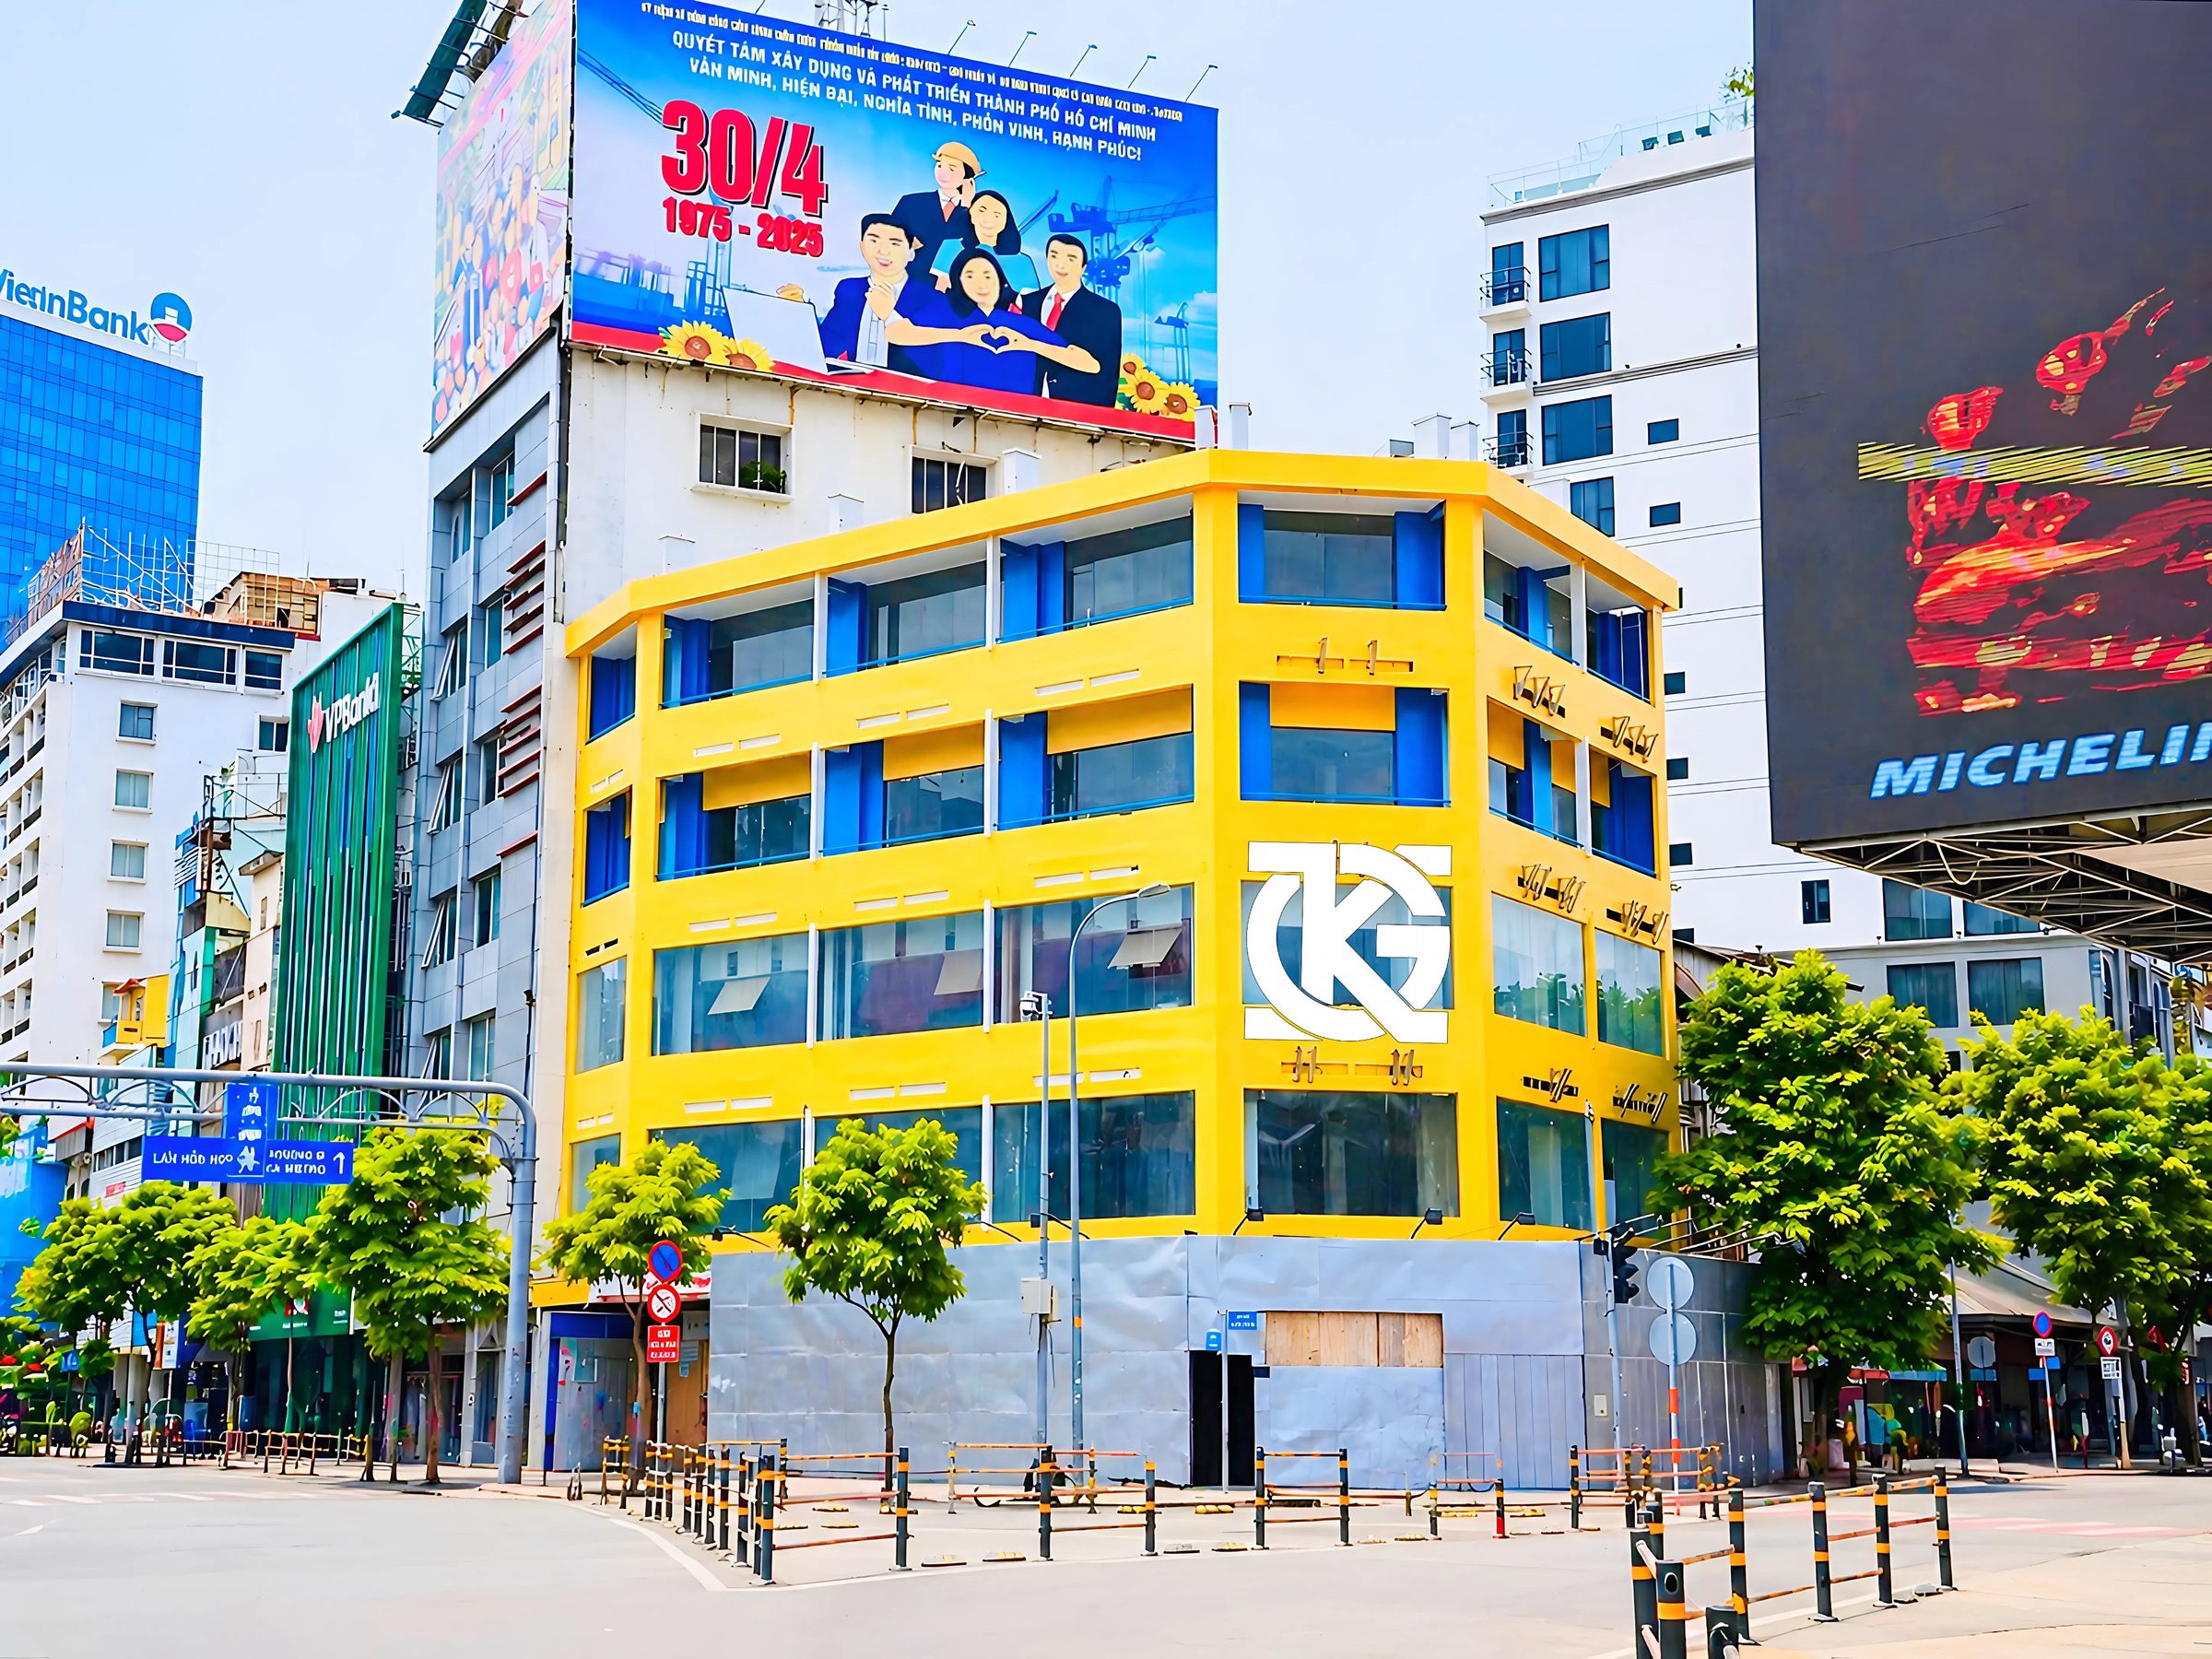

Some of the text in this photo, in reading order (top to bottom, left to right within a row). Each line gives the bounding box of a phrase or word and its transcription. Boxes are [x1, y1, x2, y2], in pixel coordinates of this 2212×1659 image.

[1117, 121, 1156, 142] MINH
[661, 99, 829, 218] 30/4
[757, 213, 824, 258] 2025
